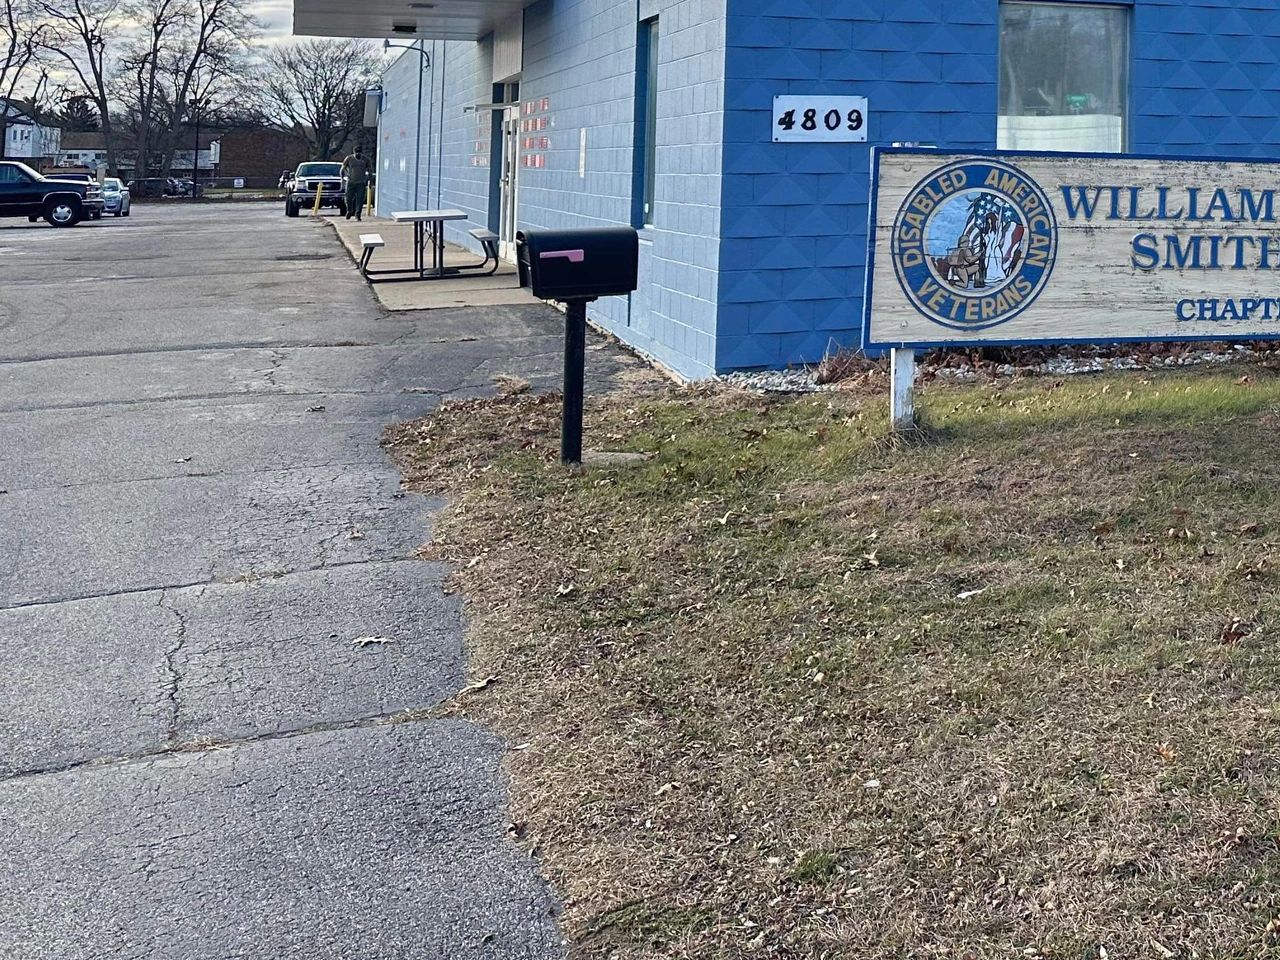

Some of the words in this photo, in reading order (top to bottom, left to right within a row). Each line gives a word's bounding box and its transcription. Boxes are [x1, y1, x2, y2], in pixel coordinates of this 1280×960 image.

[778, 109, 863, 131] 4809
[900, 170, 967, 269] DISABLED
[985, 169, 1050, 268] AMERICAN
[1059, 185, 1277, 222] WILLIAM
[917, 275, 1033, 320] VETERANS
